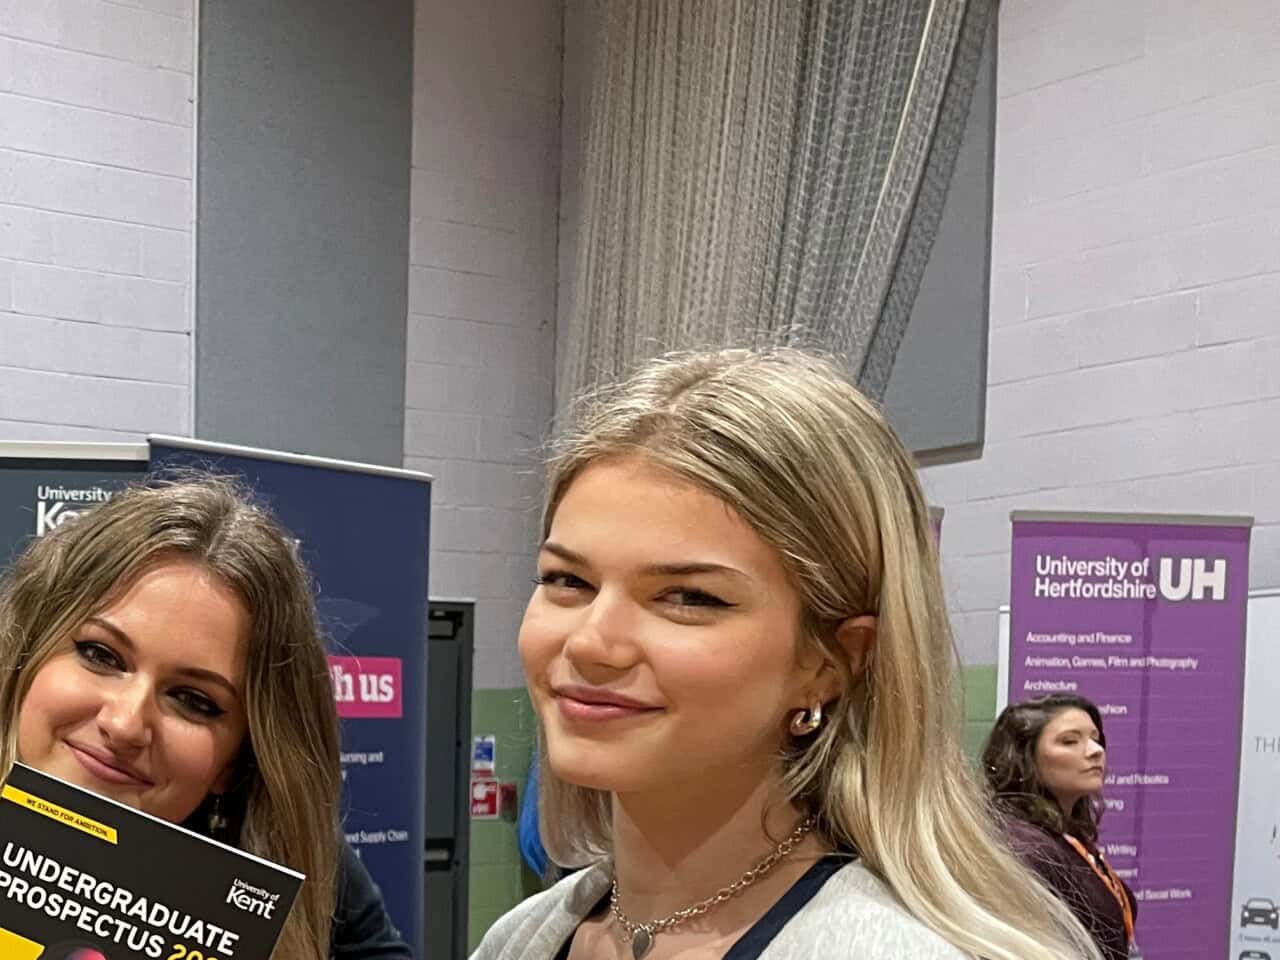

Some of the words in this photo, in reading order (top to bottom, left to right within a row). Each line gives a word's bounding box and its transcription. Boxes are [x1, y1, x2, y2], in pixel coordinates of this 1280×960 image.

[38, 486, 112, 502] University
[1036, 555, 1128, 580] University
[1130, 558, 1150, 576] of
[1034, 577, 1156, 598] Hertfordshire
[1159, 558, 1226, 600] UH
[1026, 632, 1076, 645] Accounting
[1078, 632, 1094, 644] and
[1096, 632, 1132, 644] Finance
[358, 674, 394, 702] us
[1024, 680, 1077, 692] Architecture
[1254, 736, 1280, 752] TH
[38, 803, 60, 816] STAND
[60, 812, 74, 822] FOR
[360, 830, 386, 843] Supply
[387, 829, 408, 842] Chain
[2, 842, 240, 957] UNDERGRADUATE
[233, 878, 270, 900] University
[270, 894, 280, 902] of
[1170, 888, 1192, 898] Work
[226, 885, 276, 920] Kent
